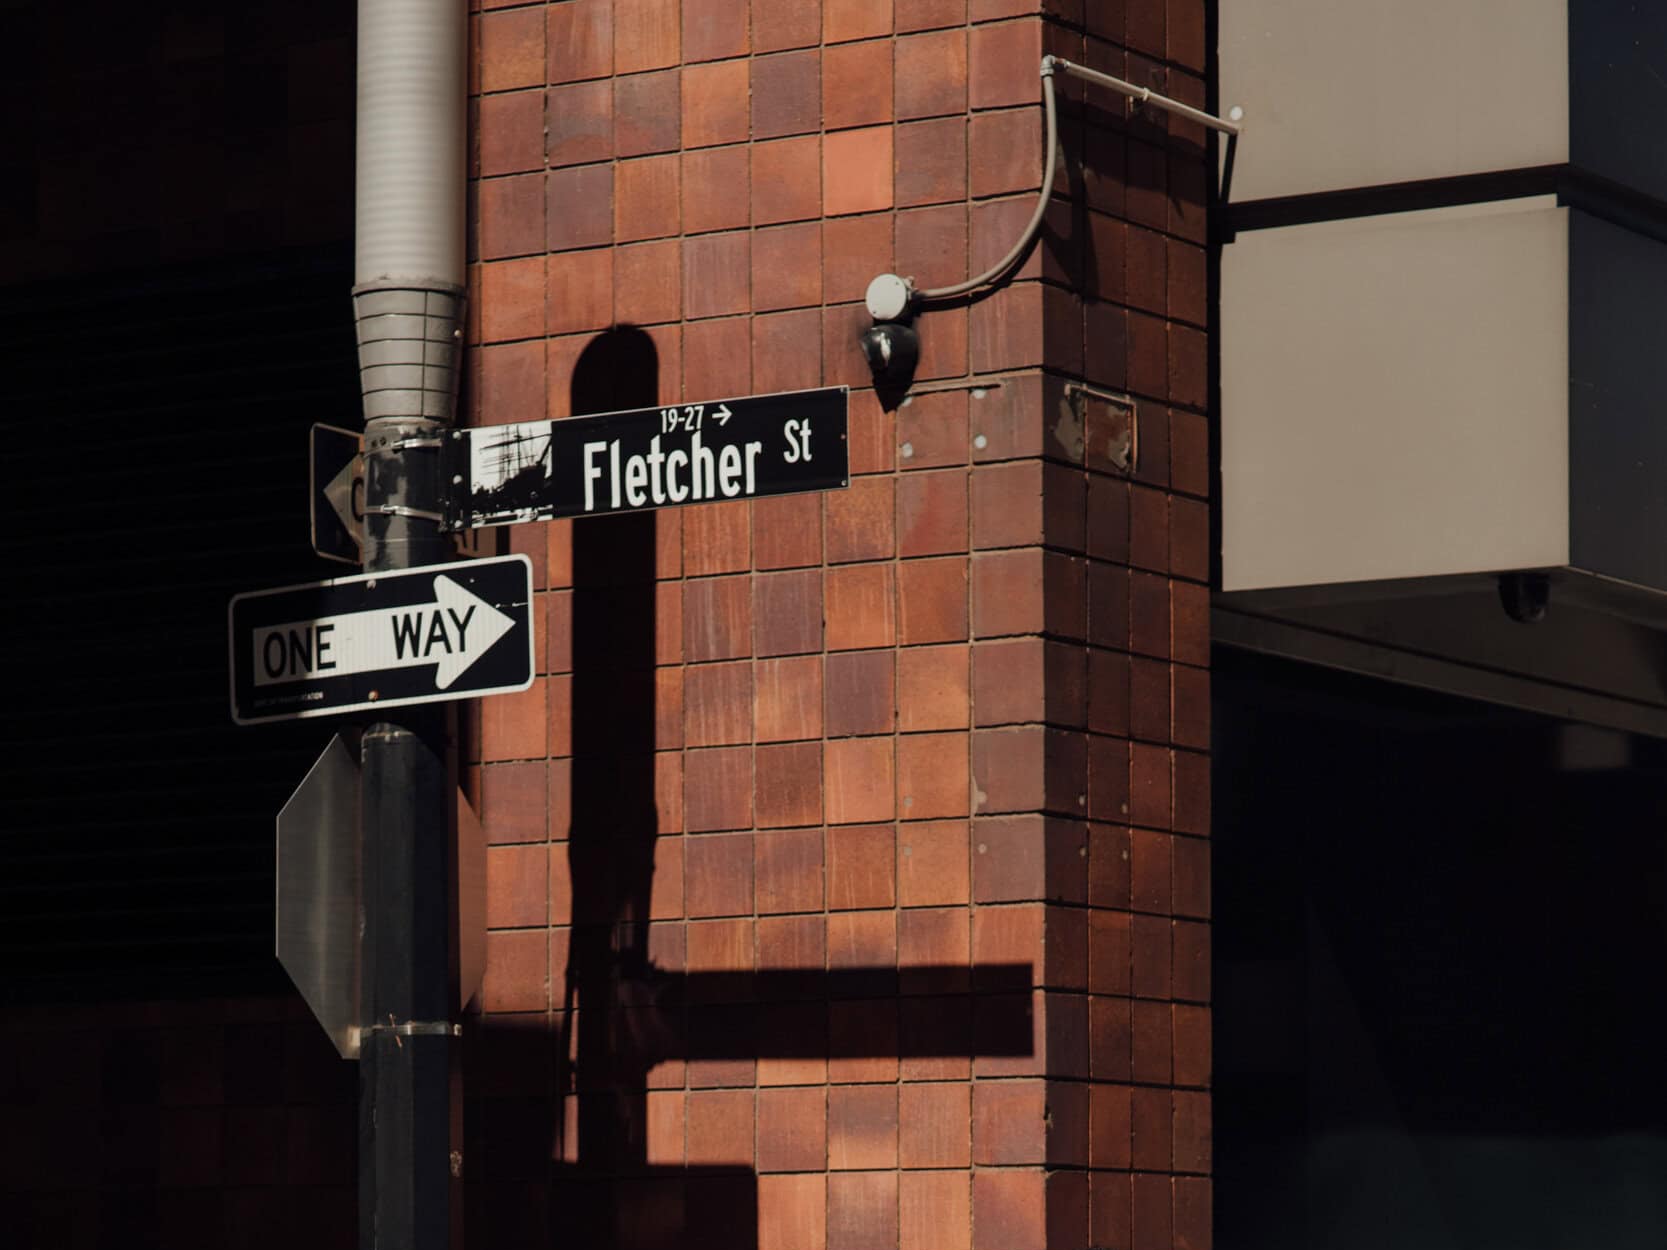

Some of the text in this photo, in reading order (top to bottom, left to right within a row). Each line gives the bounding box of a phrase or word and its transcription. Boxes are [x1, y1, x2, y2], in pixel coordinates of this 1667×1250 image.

[660, 405, 704, 434] 19-27
[583, 418, 812, 512] Fletcher St
[263, 605, 476, 679] ONE WAY
